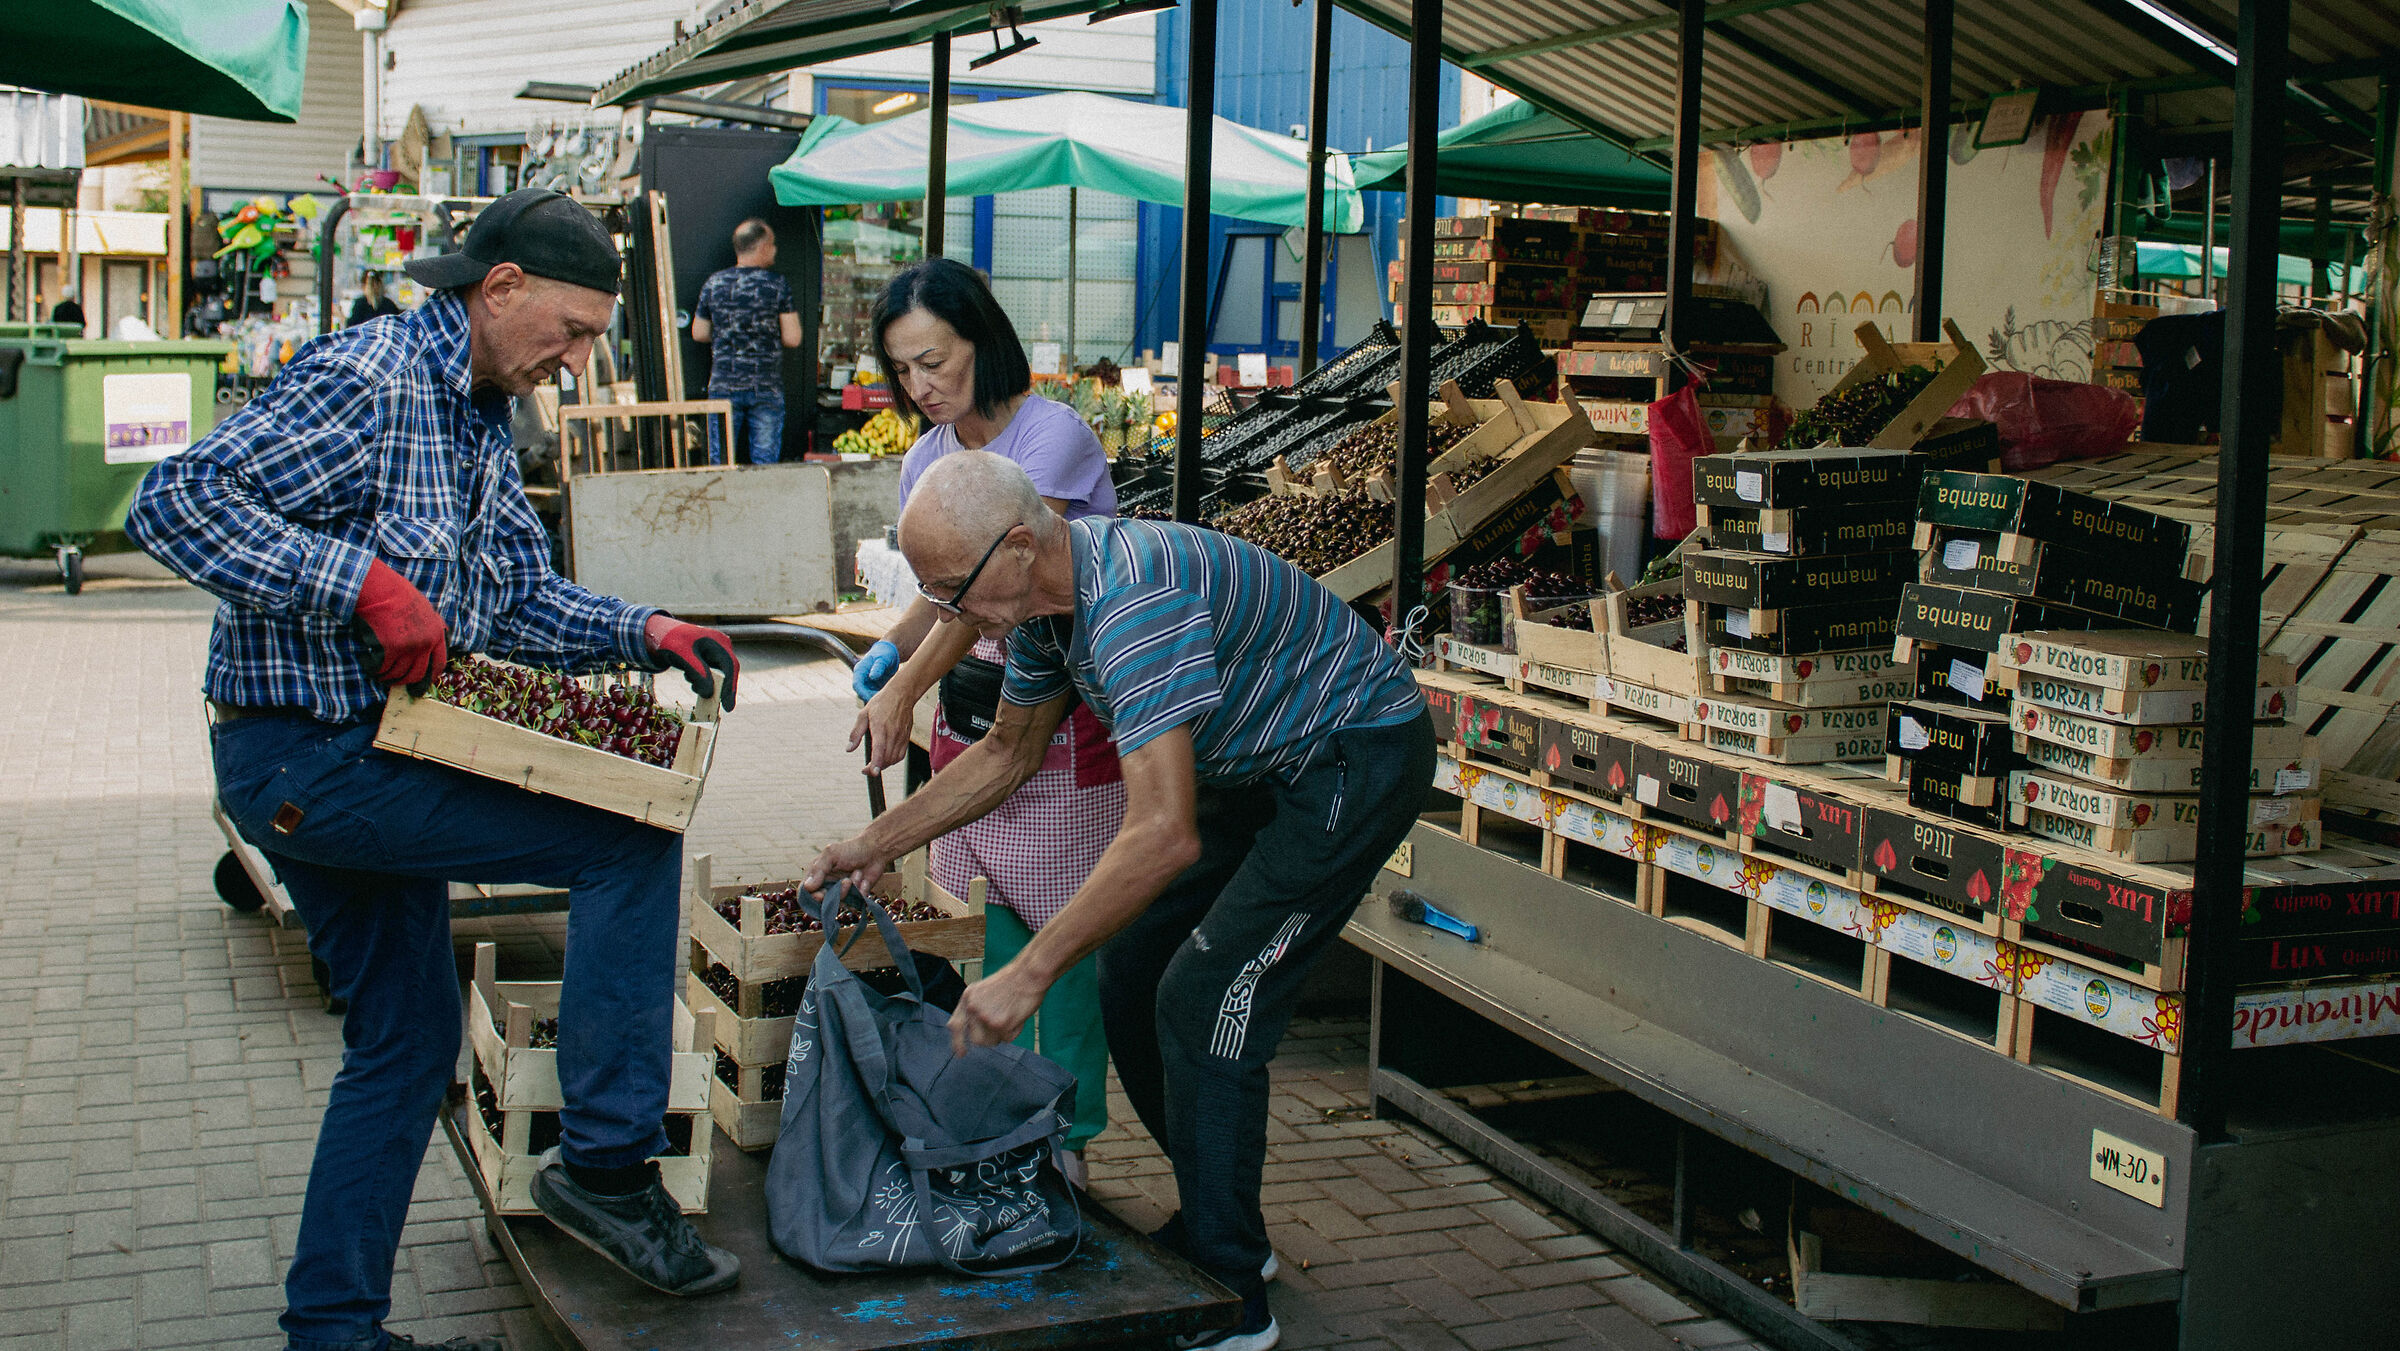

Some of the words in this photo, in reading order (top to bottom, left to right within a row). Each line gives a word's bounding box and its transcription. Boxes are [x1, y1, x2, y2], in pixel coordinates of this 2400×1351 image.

[1586, 407, 1628, 424] Mira
[1706, 473, 1736, 490] mba
[1818, 468, 1887, 486] mamba
[1938, 487, 2008, 510] mamba
[1723, 516, 1762, 534] mam
[1838, 520, 1907, 540] mamba
[2072, 508, 2145, 544] mamba
[1978, 554, 2020, 575] mba
[1694, 568, 1748, 590] mamba
[1807, 568, 1878, 587] mamba
[2084, 578, 2158, 609] mamba
[1828, 617, 1897, 638] mamba
[1917, 603, 1992, 632] mamba
[1457, 644, 1487, 665] BORJA
[1735, 652, 1771, 673] BORJA
[1833, 652, 1897, 672] BORJA
[2047, 646, 2107, 676] BORJA
[1540, 665, 1572, 686] BORJA
[1932, 671, 2008, 697] mba
[1428, 690, 1451, 714] Lux
[1624, 685, 1659, 708] BORJA
[2031, 682, 2091, 709] BORJA
[1716, 705, 1757, 727] BORJA
[1822, 710, 1879, 729] BORJA
[1509, 714, 1534, 745] Berry
[1717, 729, 1756, 753] BORJA
[1929, 727, 1964, 751] mam
[2047, 715, 2098, 745] BORJA
[1512, 738, 1527, 757] Top
[1836, 740, 1885, 757] BORJ
[2041, 740, 2091, 776] BORJA
[1923, 776, 1961, 799] mam
[2049, 784, 2101, 815] BORJA
[1817, 801, 1853, 834] Lux
[2045, 814, 2094, 848] BORJA
[2067, 869, 2102, 892] Quality
[2106, 883, 2154, 923] Lux
[2272, 891, 2332, 913] Quality
[2345, 889, 2400, 919] Lux
[2270, 940, 2327, 971] Lux
[2103, 1146, 2148, 1184] VM-30
